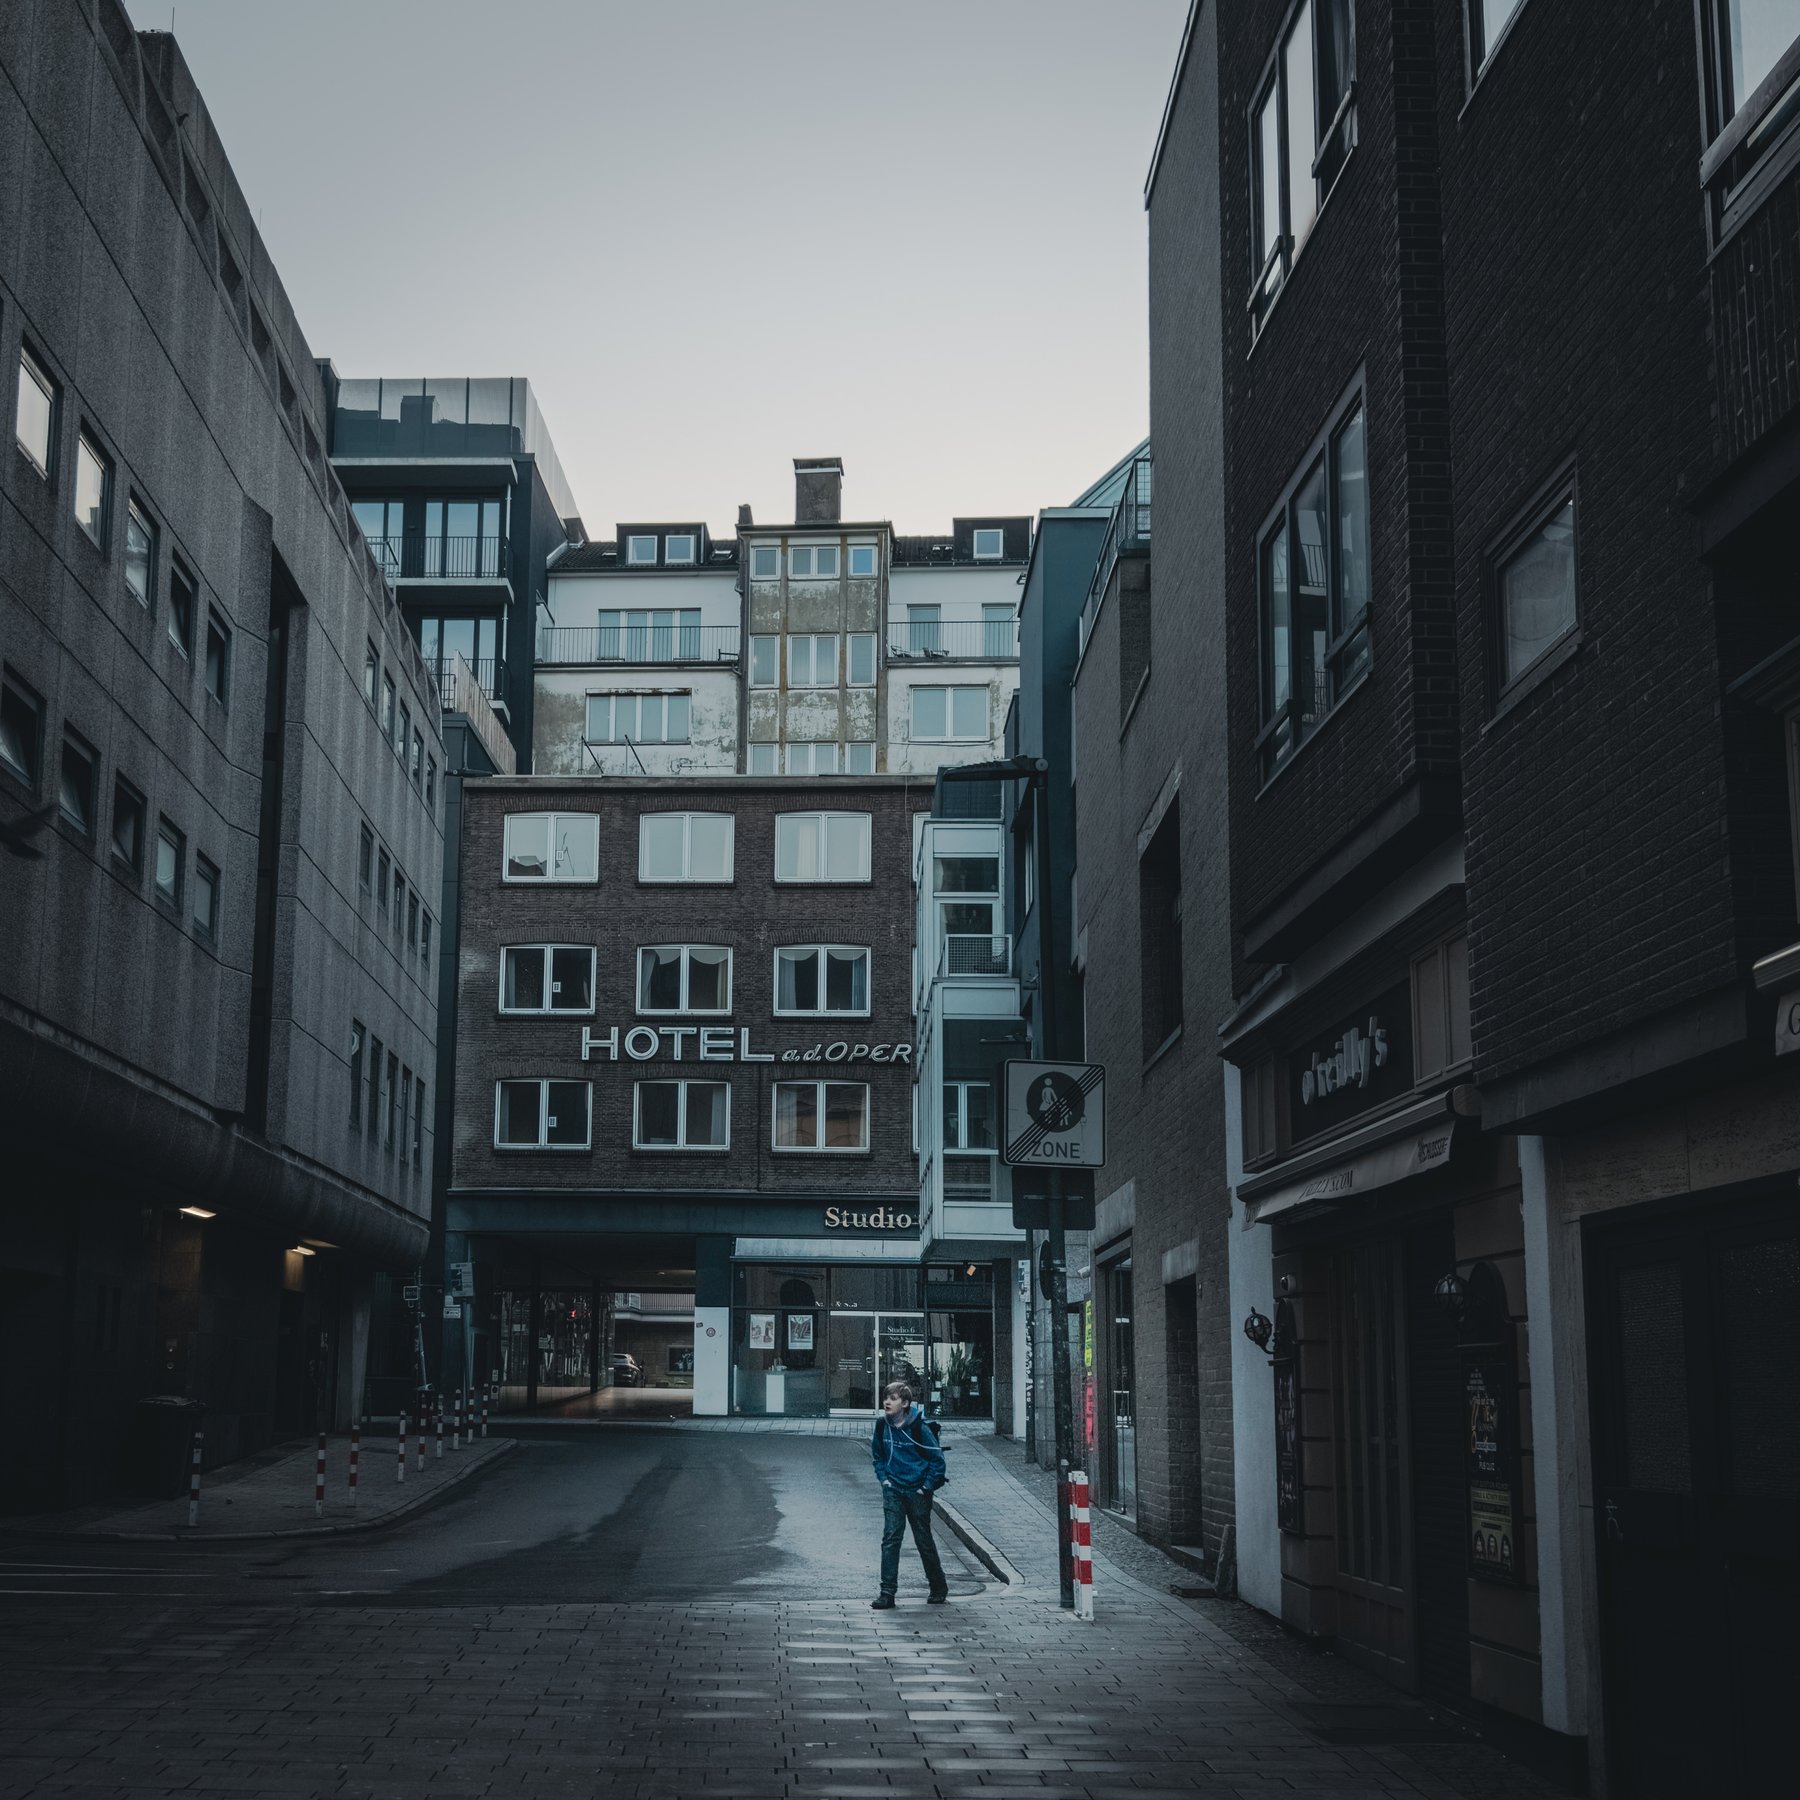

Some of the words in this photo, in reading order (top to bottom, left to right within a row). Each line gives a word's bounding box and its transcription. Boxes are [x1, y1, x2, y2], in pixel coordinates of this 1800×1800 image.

[581, 1025, 775, 1062] HOTEL
[1031, 1141, 1080, 1159] ZONE
[824, 1206, 912, 1229] Studio
